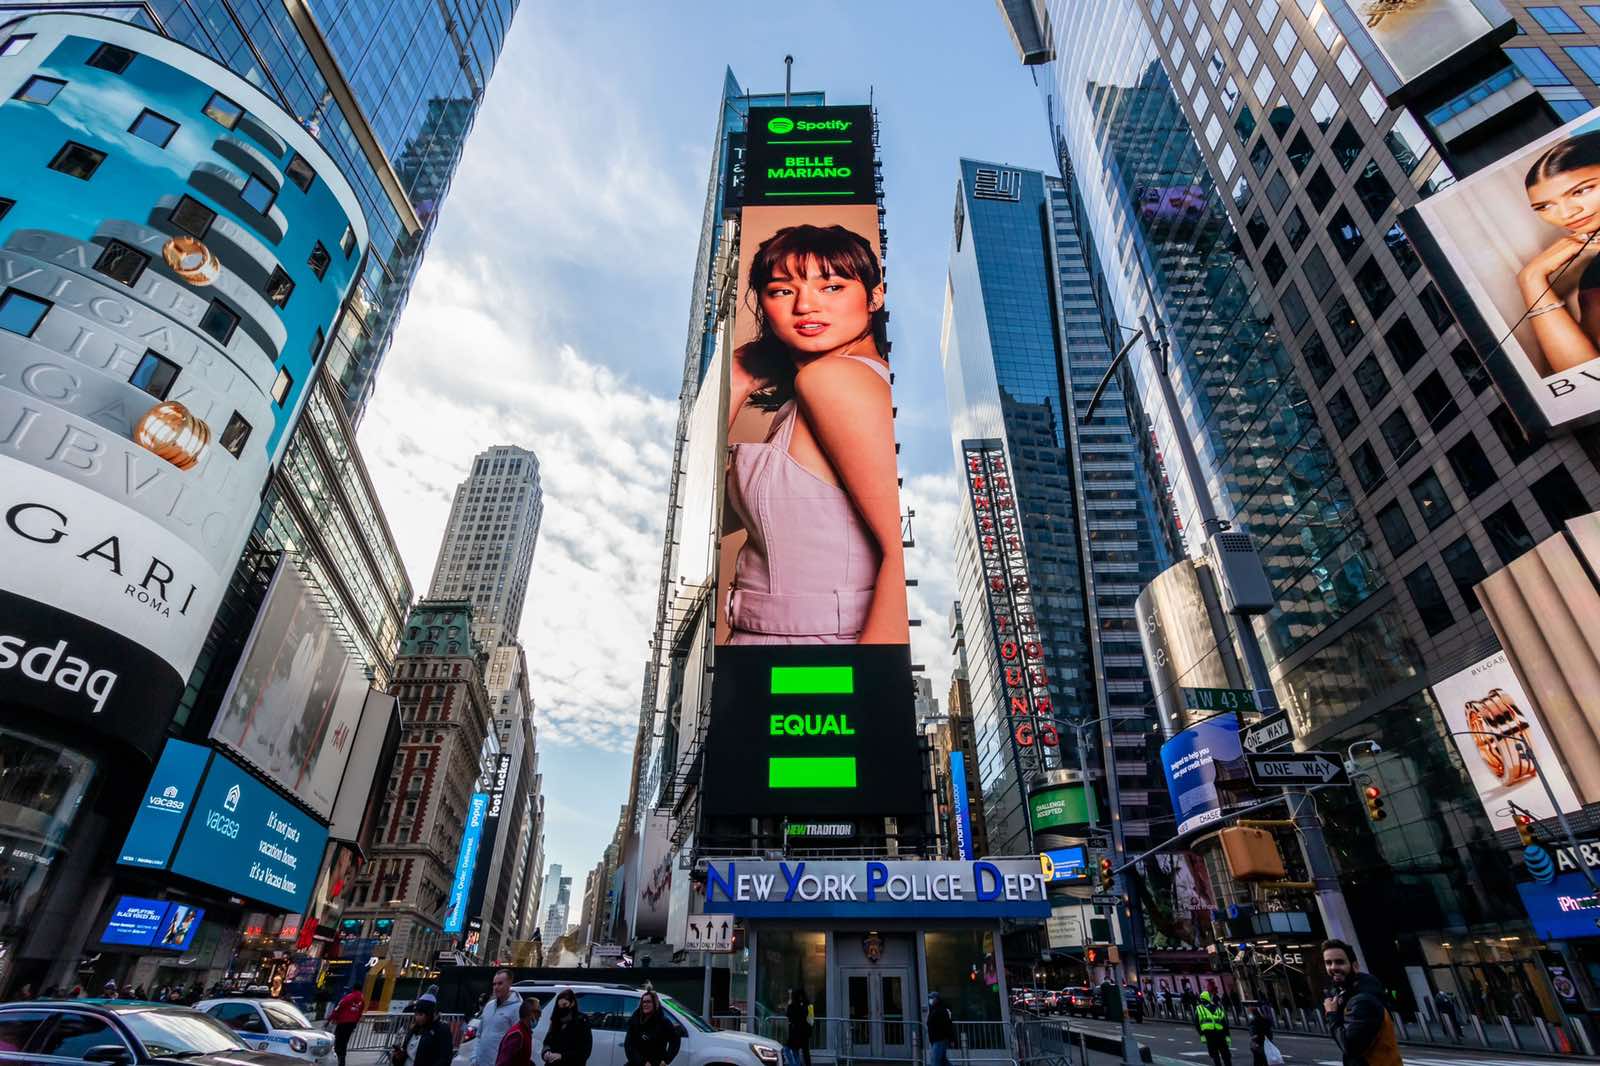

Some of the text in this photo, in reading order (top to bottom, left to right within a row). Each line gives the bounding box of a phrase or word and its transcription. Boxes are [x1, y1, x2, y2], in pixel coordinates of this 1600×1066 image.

[797, 120, 847, 132] Spotify
[785, 156, 834, 167] BELLE
[767, 167, 852, 179] MARIANO
[5, 502, 198, 617] GARI
[124, 584, 171, 618] ROMA
[0, 634, 118, 714] sdaq
[1199, 691, 1214, 707] W
[1221, 691, 1239, 708] 43
[770, 714, 855, 736] EQUAL
[1247, 721, 1285, 748] ONE WAY
[494, 756, 510, 791] Locker
[1264, 762, 1331, 775] ONE WAY
[149, 796, 185, 810] vacasa
[470, 798, 485, 828] gopuff
[488, 793, 503, 818] Foot
[1036, 801, 1066, 812] CHALLENGE
[1036, 808, 1063, 819] ACCEPTED
[205, 809, 240, 839] vacasa
[284, 821, 297, 841] just
[258, 839, 283, 861] vacation
[264, 867, 283, 889] Vacasa
[705, 861, 1049, 901] NEW YORK POLICE DEPT
